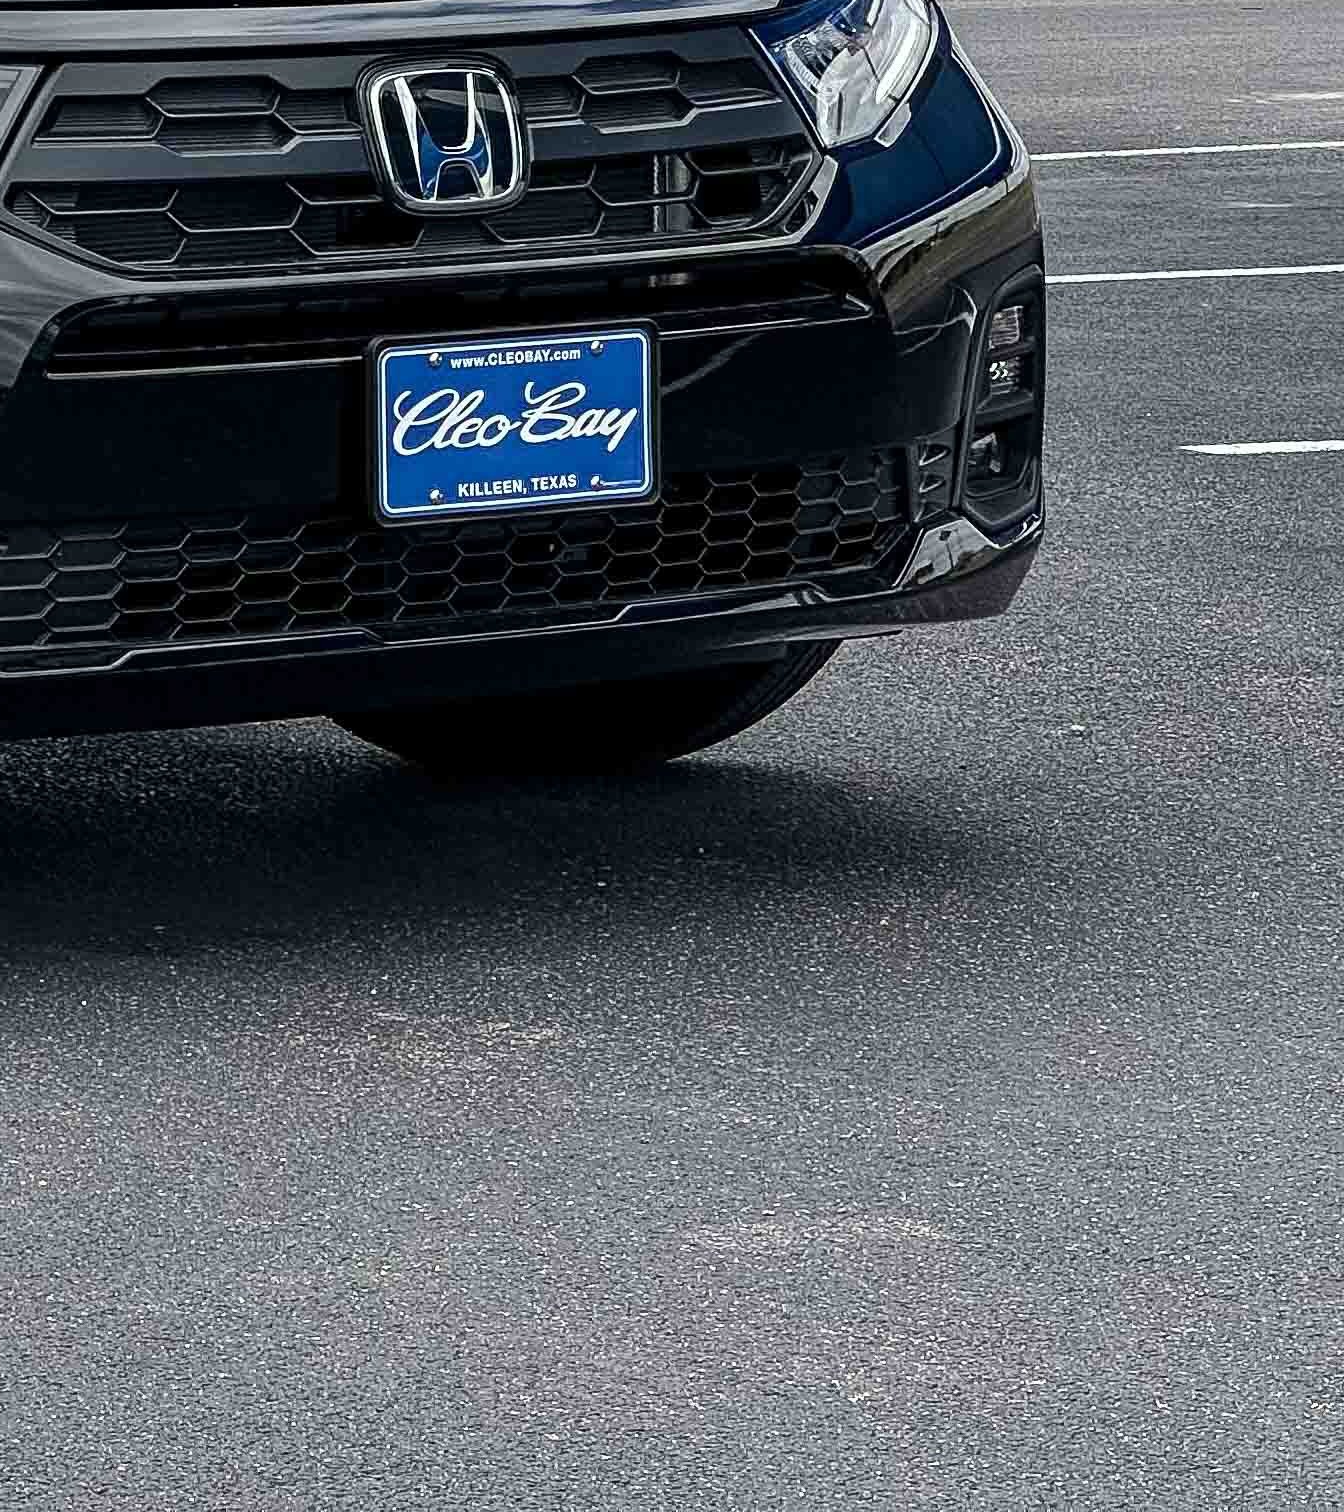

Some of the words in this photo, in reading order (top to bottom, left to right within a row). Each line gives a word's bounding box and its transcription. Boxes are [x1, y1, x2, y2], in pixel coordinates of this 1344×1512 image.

[450, 348, 582, 369] www.CLEOBAY.com
[392, 388, 519, 456] Cleo
[519, 381, 638, 453] Bay
[457, 479, 527, 498] KILLEEN,
[530, 474, 578, 491] TEXAS
